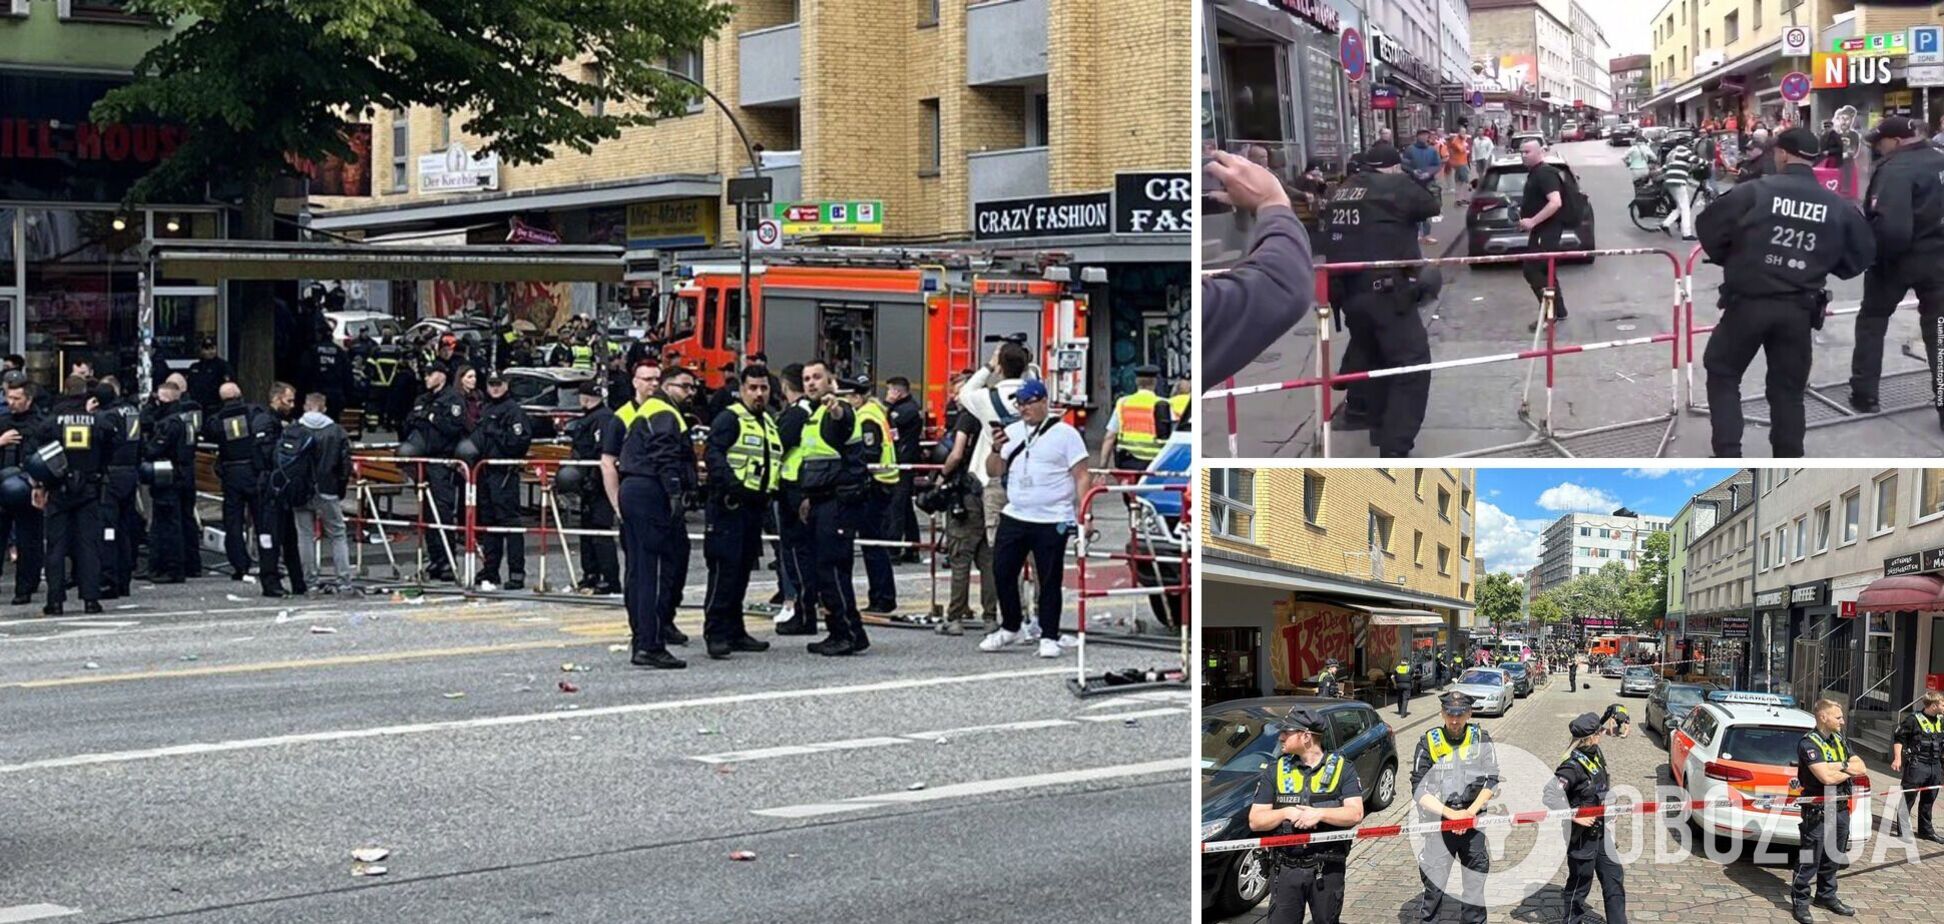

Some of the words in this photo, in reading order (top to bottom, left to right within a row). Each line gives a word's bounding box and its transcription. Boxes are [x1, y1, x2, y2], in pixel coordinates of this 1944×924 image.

[1790, 32, 1802, 43] 30
[1919, 32, 1932, 50] P
[1144, 178, 1191, 201] CR
[978, 203, 1034, 234] CRAZY
[1035, 202, 1108, 230] FASHION
[1332, 208, 1360, 225] 2213
[1772, 196, 1828, 223] POLIZEI
[761, 227, 773, 239] 30
[1770, 225, 1817, 252] 2213
[1765, 254, 1783, 266] SH
[57, 414, 95, 425] POLIZEI
[1276, 795, 1300, 804] POLIZEI
